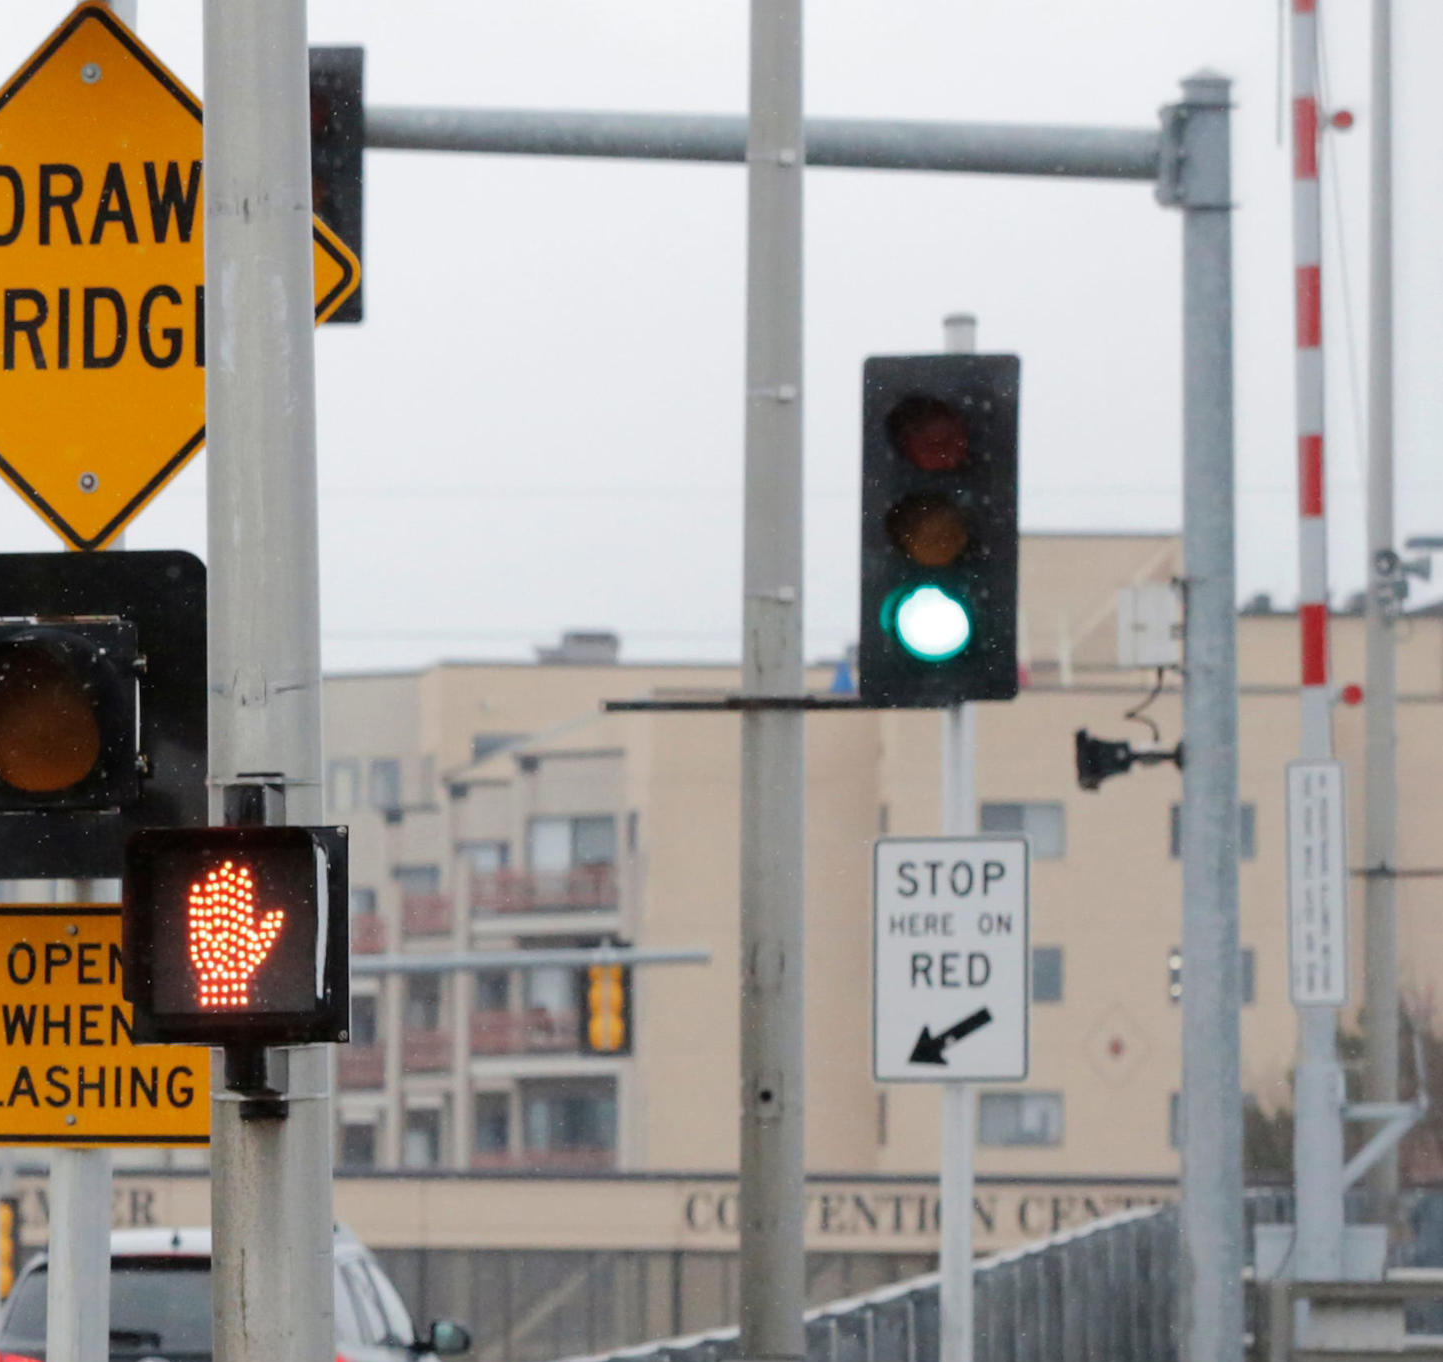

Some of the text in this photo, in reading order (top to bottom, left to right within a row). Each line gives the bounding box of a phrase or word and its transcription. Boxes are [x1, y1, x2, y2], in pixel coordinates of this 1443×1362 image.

[896, 861, 1006, 898] STOP
[889, 912, 1013, 936] HERE ON
[910, 953, 991, 988] RED
[2, 1004, 134, 1046] WHEN
[685, 1193, 998, 1233] COENTIN
